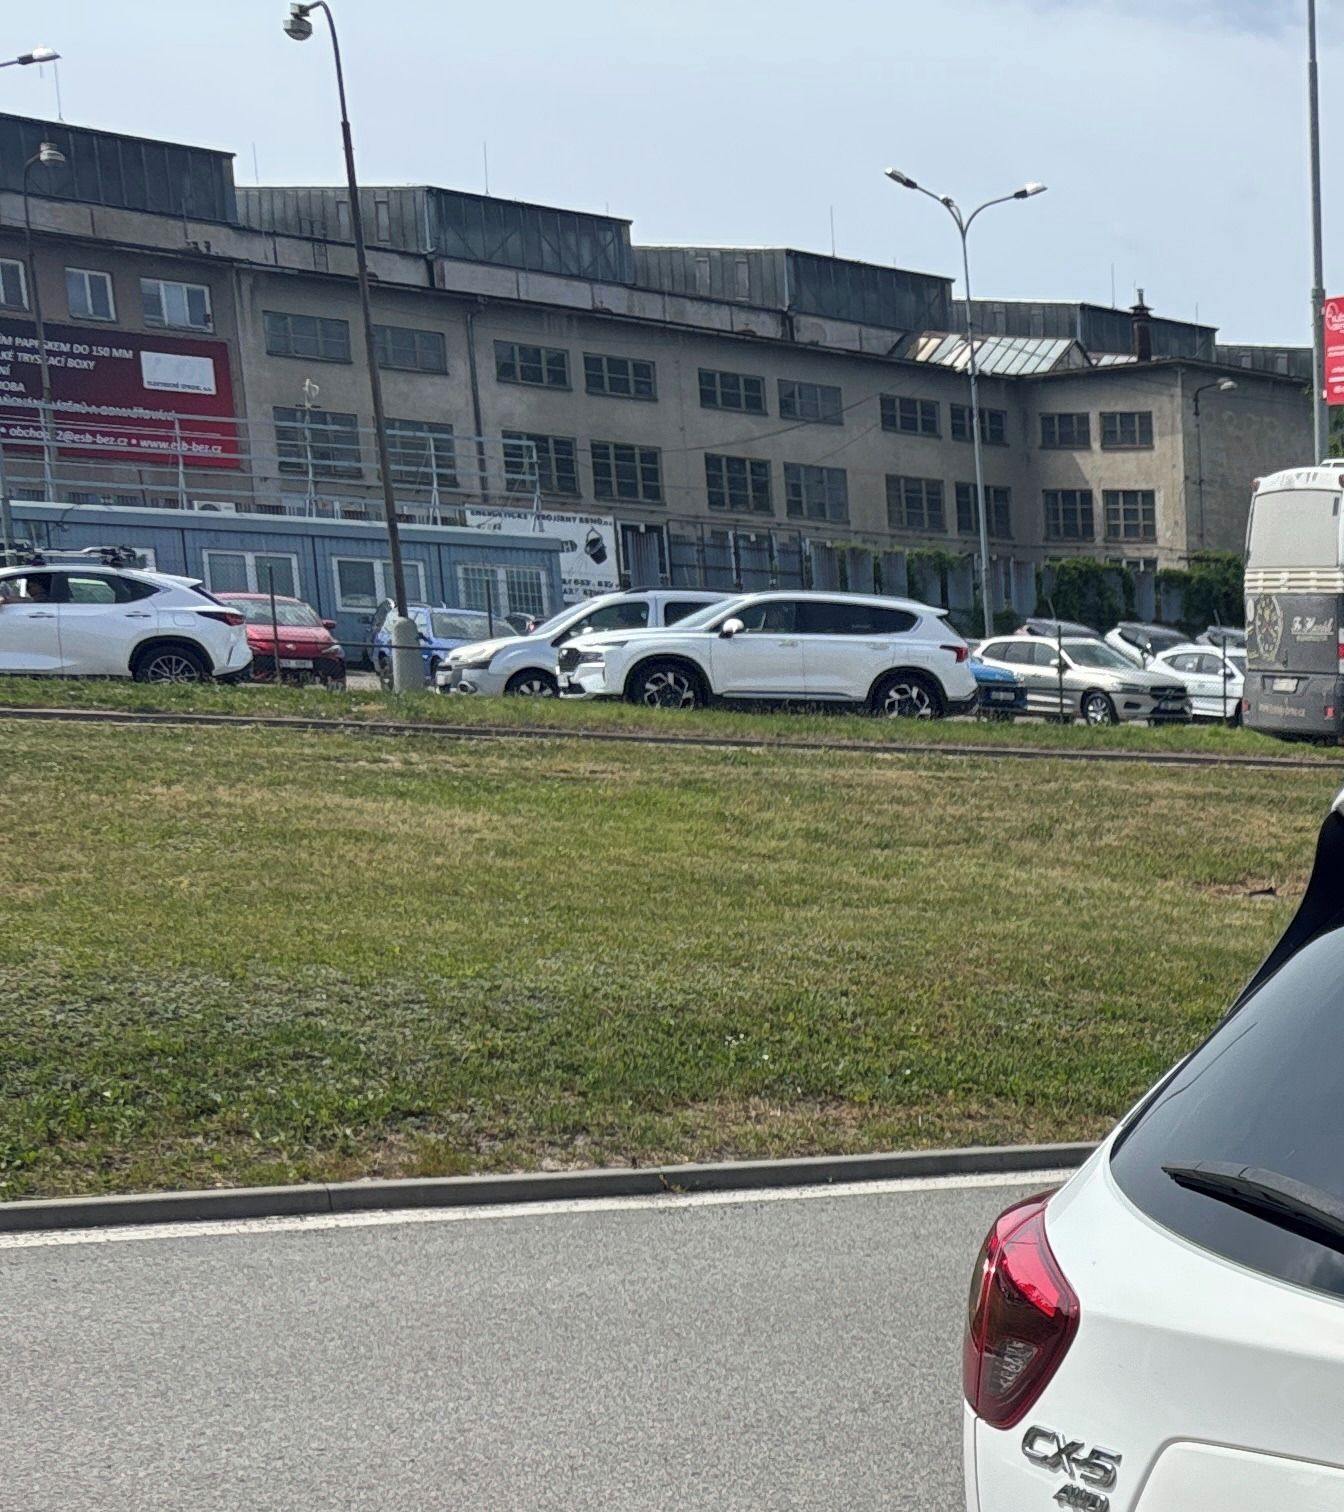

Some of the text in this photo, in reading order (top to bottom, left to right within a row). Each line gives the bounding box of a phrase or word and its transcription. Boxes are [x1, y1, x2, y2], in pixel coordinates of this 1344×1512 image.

[73, 343, 90, 354] DO
[112, 348, 134, 360] MM
[1022, 1425, 1122, 1488] CX-5
